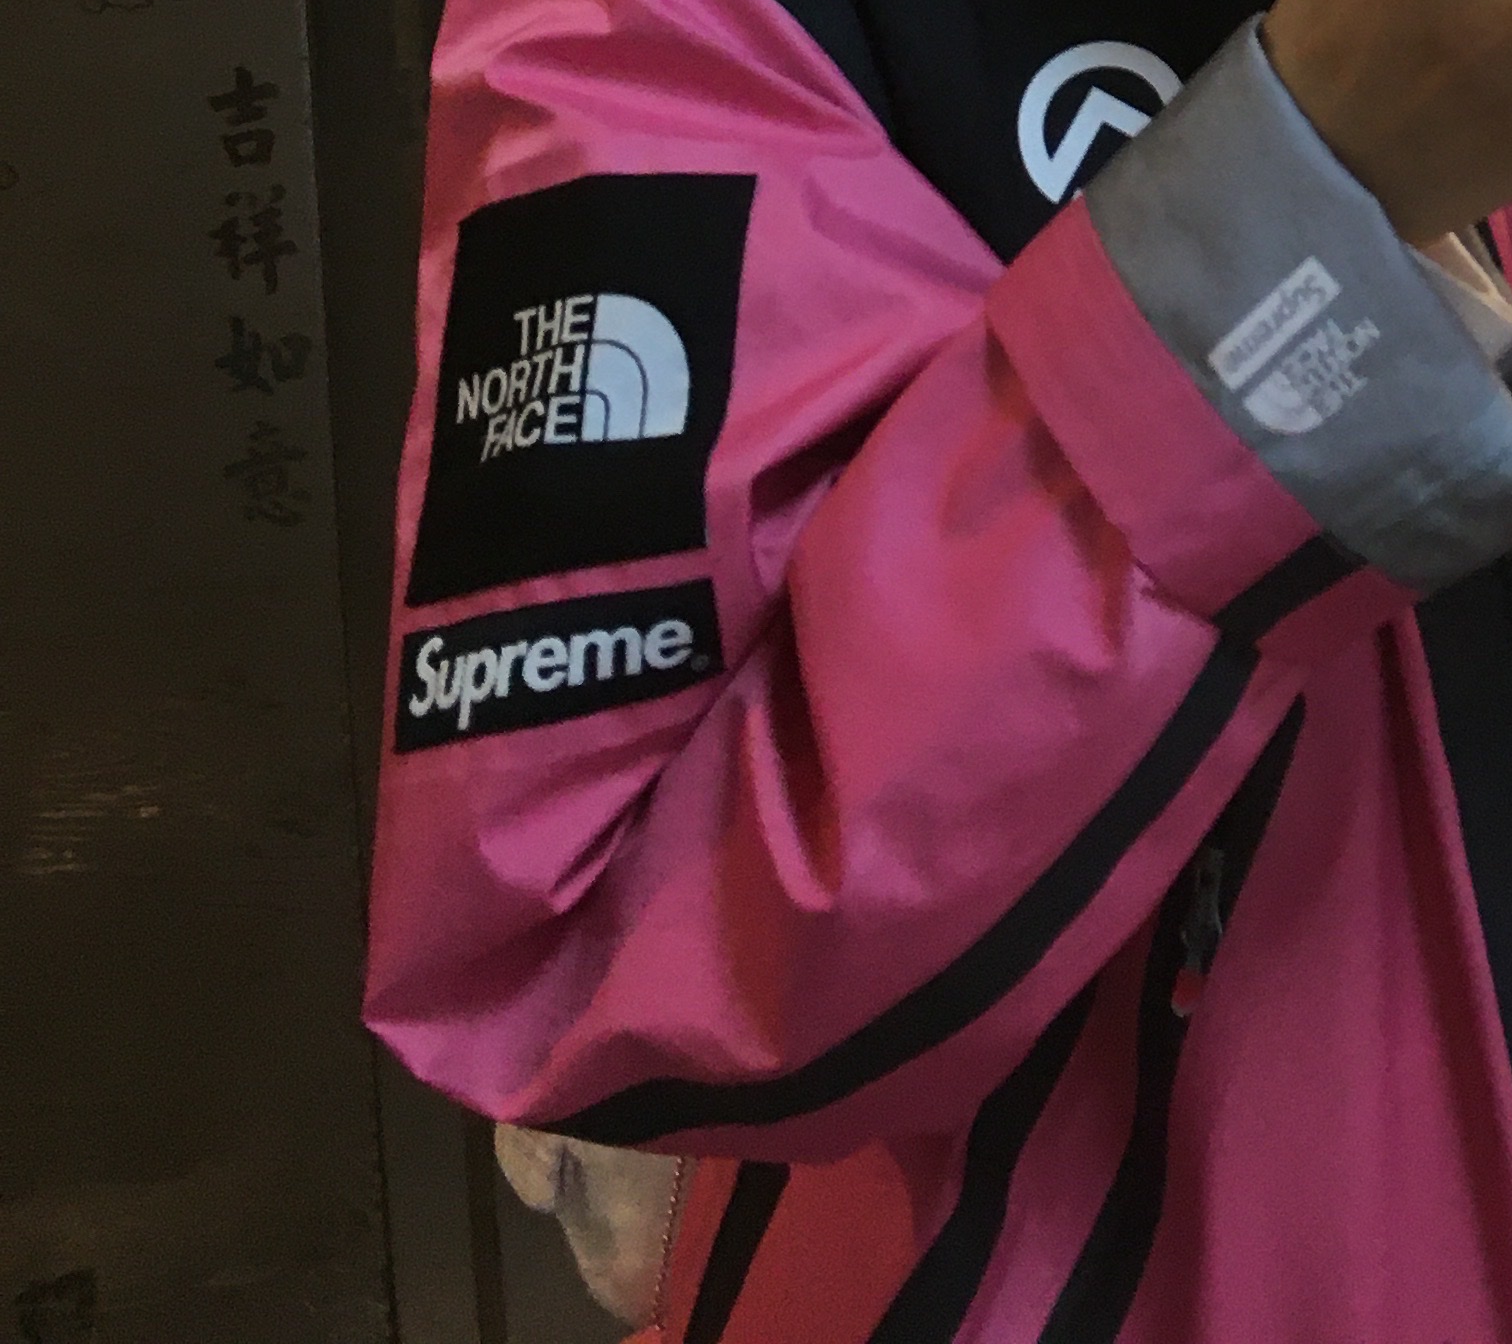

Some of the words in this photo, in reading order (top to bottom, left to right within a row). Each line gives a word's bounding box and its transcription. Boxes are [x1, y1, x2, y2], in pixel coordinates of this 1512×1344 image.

[205, 66, 313, 529] 吉祥如意
[514, 295, 594, 355] THE
[455, 344, 585, 424] NORTH
[480, 395, 582, 463] FACE
[410, 618, 694, 730] Supreme
